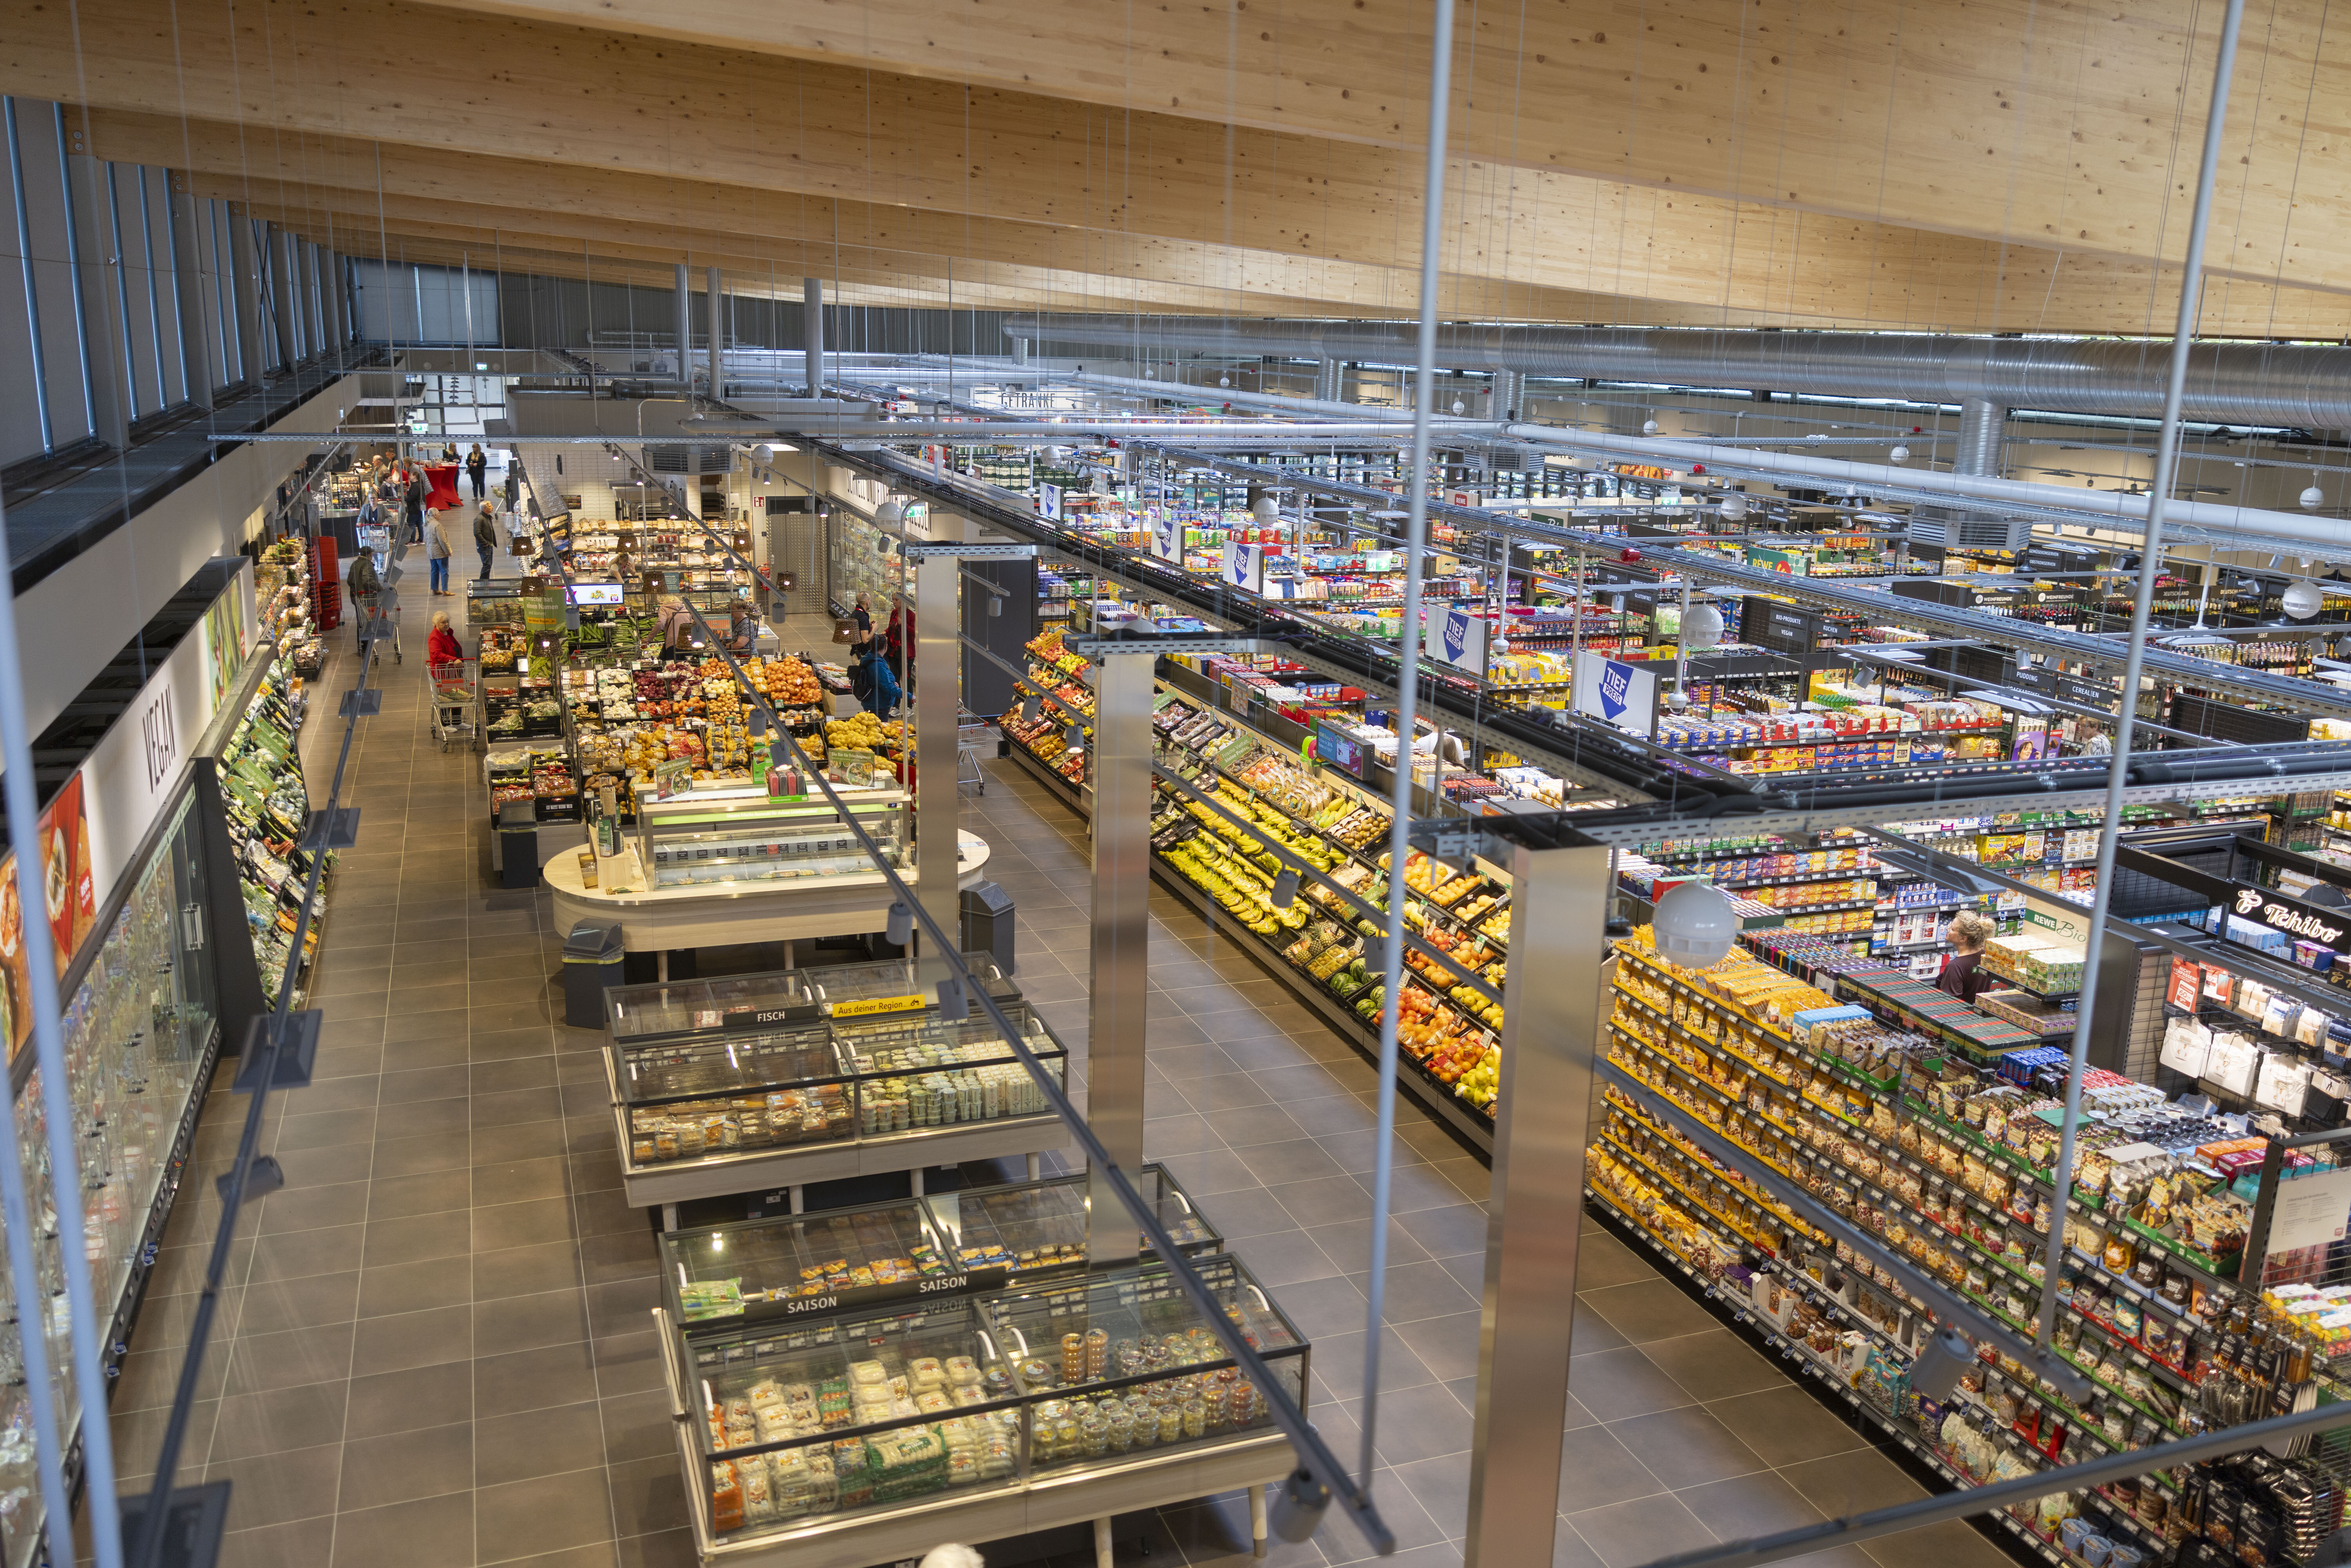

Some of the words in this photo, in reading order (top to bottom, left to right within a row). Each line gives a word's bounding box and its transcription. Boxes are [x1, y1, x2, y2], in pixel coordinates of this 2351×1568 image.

[1237, 548, 1248, 565] TIEF
[1237, 561, 1245, 573] PREIS
[1753, 558, 1773, 570] REWE
[1635, 593, 1651, 601] GLUTENFREI
[1776, 614, 1801, 624] BIO-PRODUKTE
[1449, 617, 1464, 639] TIEF
[1823, 625, 1838, 633] KUCHEN
[1448, 632, 1460, 648] PREIS
[1607, 666, 1627, 693] TIEF
[2016, 671, 2038, 682] PUDDING
[1605, 685, 1621, 703] PREIS
[2072, 686, 2099, 698] CEREALIEN
[1158, 695, 1170, 705] Vielfalt,
[143, 683, 176, 795] VEGAN
[1221, 748, 1235, 759] Frische
[1234, 739, 1250, 751] Vielfalt,
[1224, 753, 1237, 763] kleine
[1236, 746, 1249, 756] Preise.
[672, 760, 689, 768] Frischegenuss
[238, 768, 251, 780] kleine
[249, 777, 262, 789] Preise.
[241, 762, 255, 776] Frische
[255, 772, 269, 788] Vielfalt,
[231, 782, 245, 796] Frische
[80, 876, 90, 898] REWE
[2034, 914, 2056, 928] REWE
[2056, 921, 2087, 942] Bio
[2264, 902, 2343, 943] Tchibo
[2173, 967, 2197, 983] VERPASSEN!
[2178, 965, 2192, 974] NICHT
[854, 1004, 876, 1013] deiner
[878, 1001, 903, 1011] Region
[757, 1011, 785, 1022] FISCH
[1924, 1022, 1934, 1030] JACOBS
[1947, 1034, 1958, 1042] JACOBS
[1970, 1045, 1982, 1053] JACOBS
[2085, 1235, 2100, 1243] KOKOS
[2138, 1261, 2152, 1272] KOKOS
[920, 1276, 967, 1293] SAISON
[2165, 1285, 2179, 1294] CHIPS
[2166, 1277, 2181, 1289] KOKOS
[1729, 1289, 1747, 1304] TROCKENPFLAUMEN
[788, 1296, 837, 1313] SAISON
[1760, 1309, 1781, 1328] STUDENTENFUTTER
